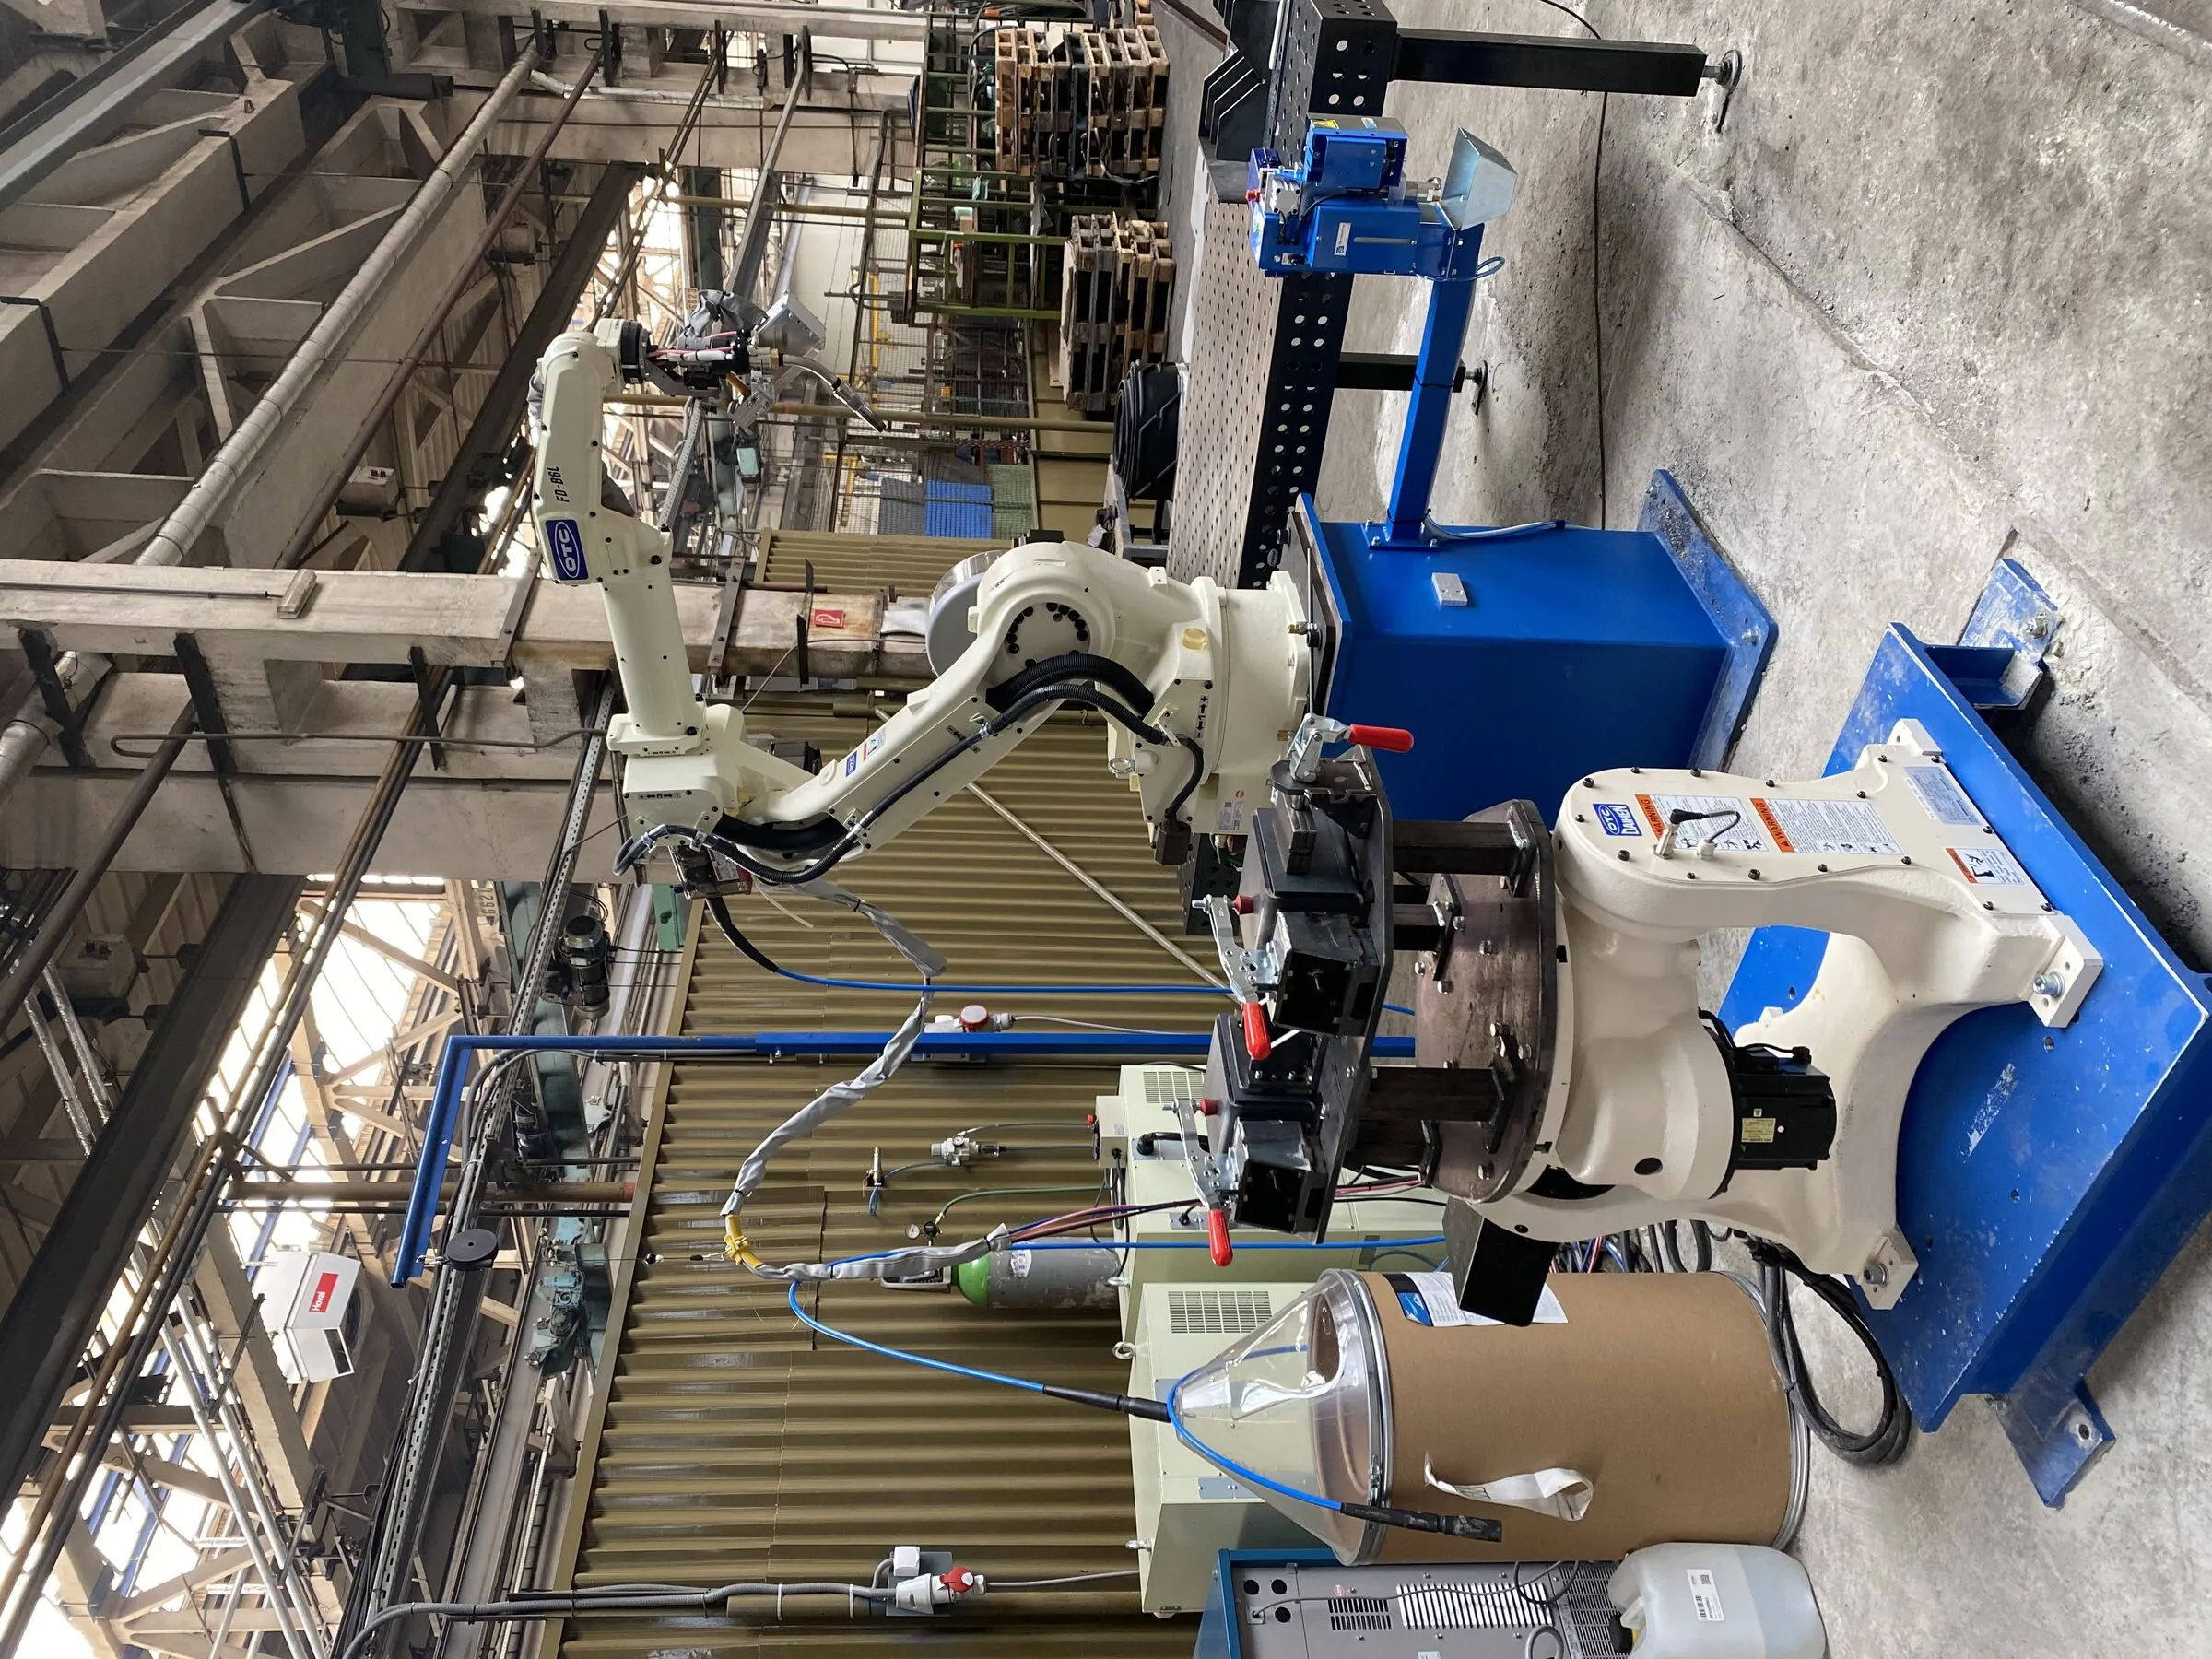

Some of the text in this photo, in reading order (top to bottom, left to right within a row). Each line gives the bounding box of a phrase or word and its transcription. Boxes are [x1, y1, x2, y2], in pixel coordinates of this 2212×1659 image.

[547, 466, 570, 502] FD-B6L
[558, 529, 577, 571] OTC
[1601, 809, 1618, 831] OTC
[1607, 806, 1640, 834] DAIHEN
[1757, 802, 1784, 839] WARNING
[312, 1292, 326, 1311] Hoval
